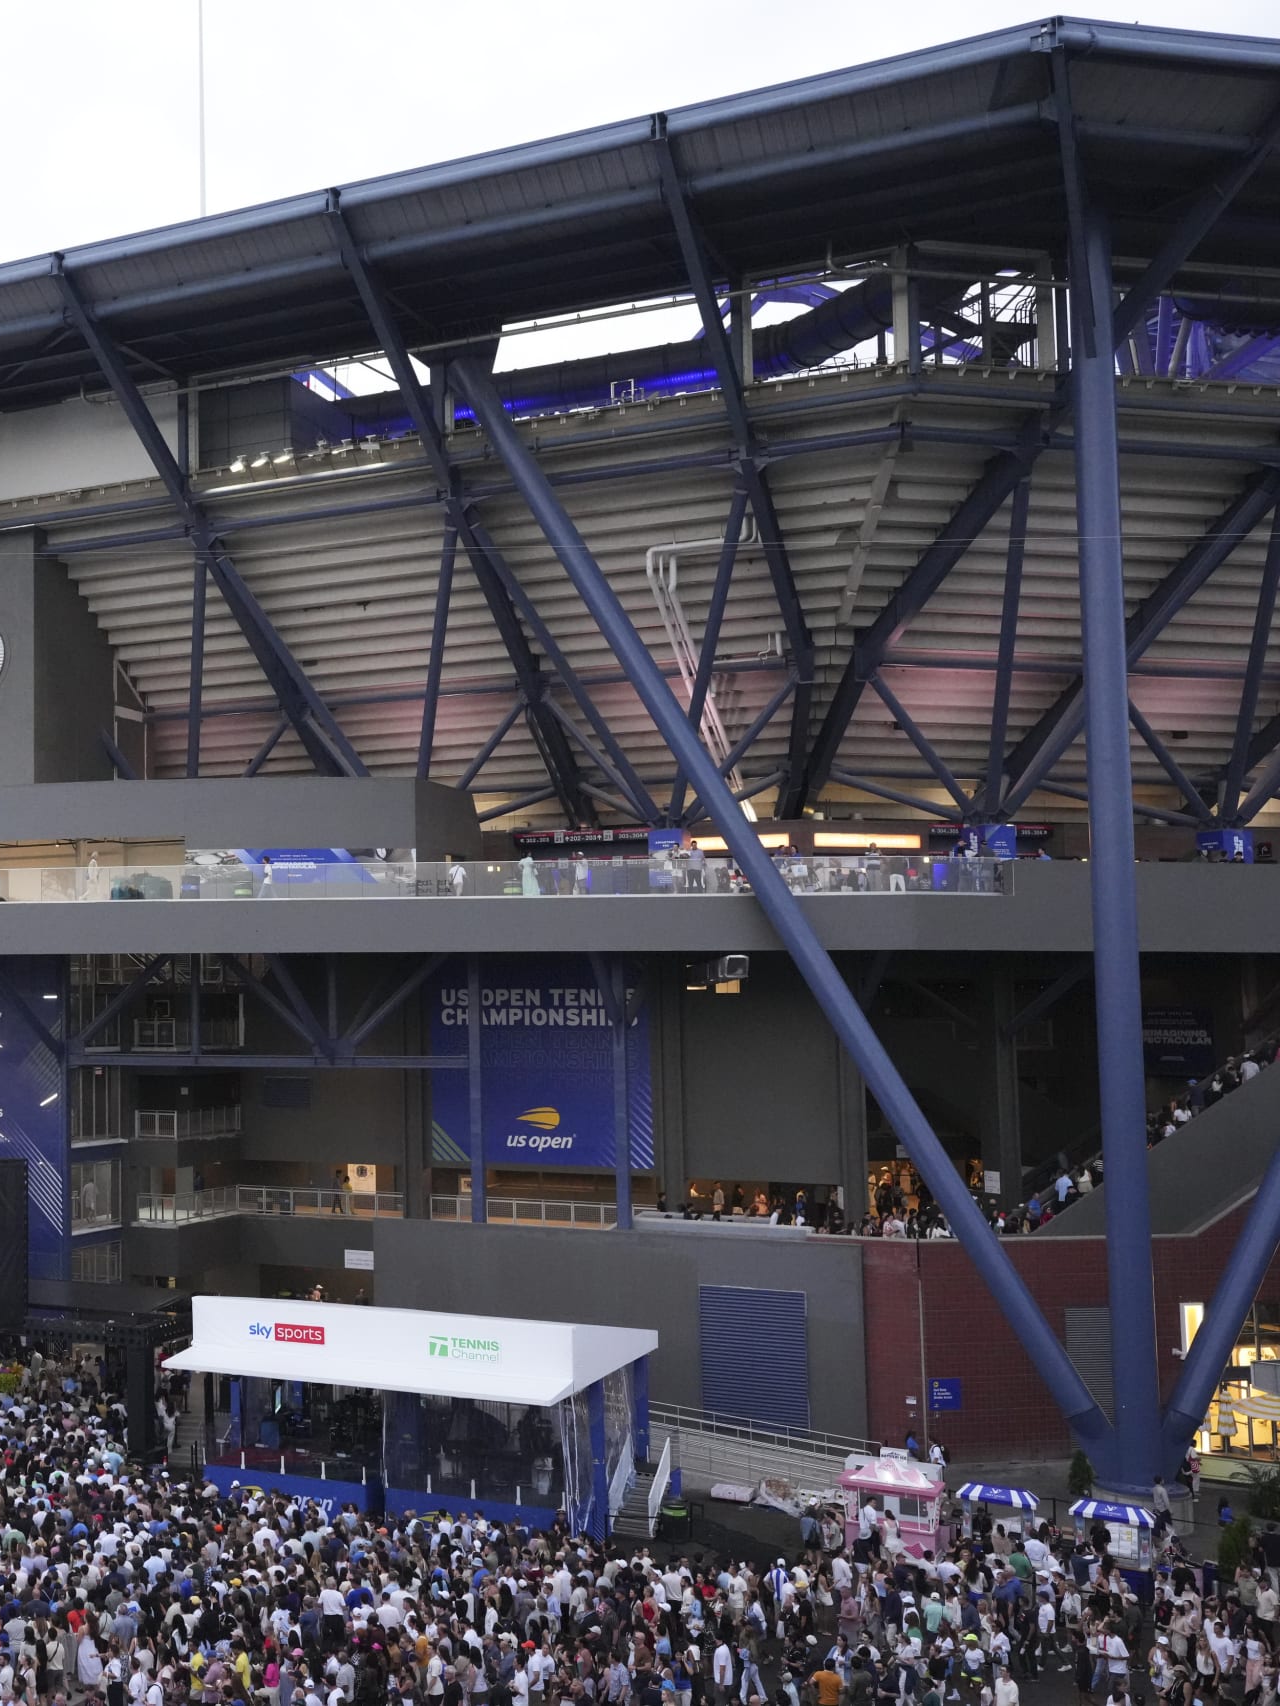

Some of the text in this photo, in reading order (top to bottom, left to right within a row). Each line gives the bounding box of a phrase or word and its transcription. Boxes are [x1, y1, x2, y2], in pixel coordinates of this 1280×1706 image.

[441, 988, 636, 1006] US OPEN TENS
[441, 1008, 639, 1026] CHMPIONSHI
[506, 1134, 573, 1152] us open
[249, 1322, 323, 1341] sky sports
[450, 1337, 500, 1352] TENNIS
[451, 1349, 500, 1363] Channel
